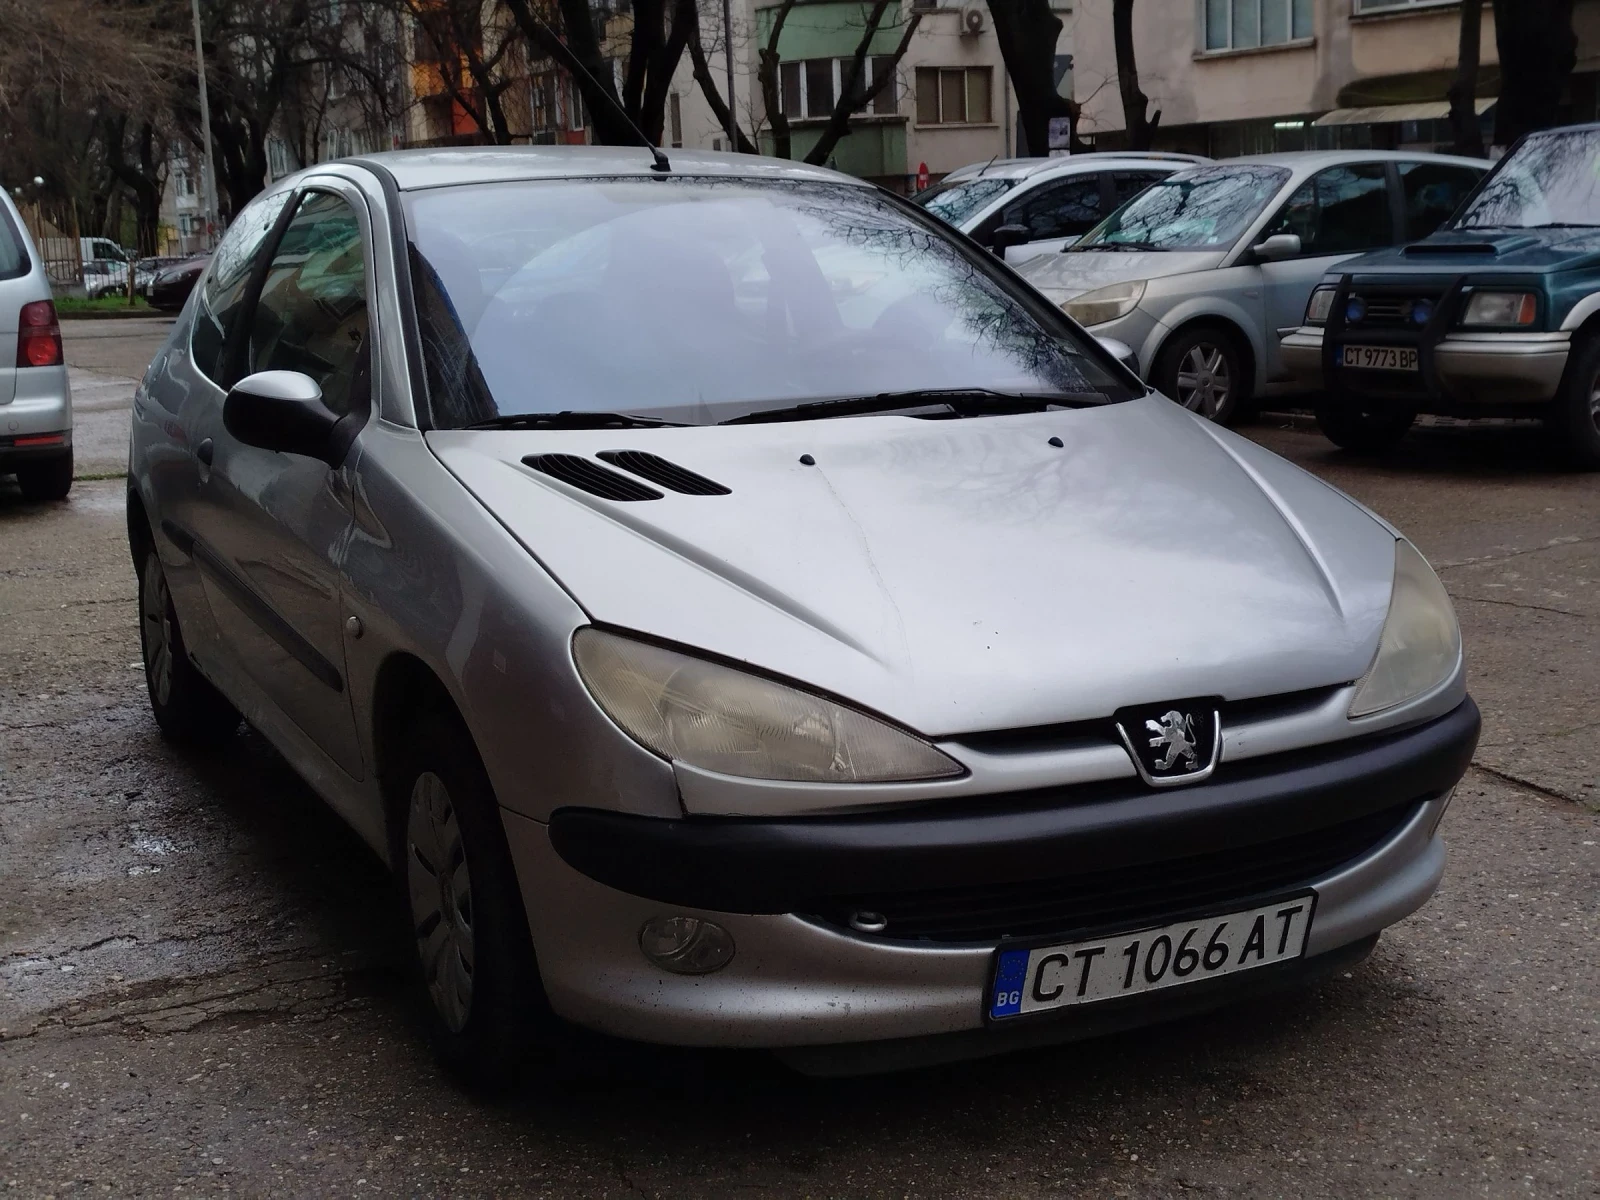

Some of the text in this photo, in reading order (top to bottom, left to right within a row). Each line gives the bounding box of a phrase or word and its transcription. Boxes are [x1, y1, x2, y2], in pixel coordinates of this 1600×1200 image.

[1344, 347, 1362, 365] CT
[1364, 348, 1397, 367] 9773
[1400, 350, 1417, 368] BP
[1032, 905, 1304, 1002] CT 1066 AT
[996, 990, 1020, 1007] BG
